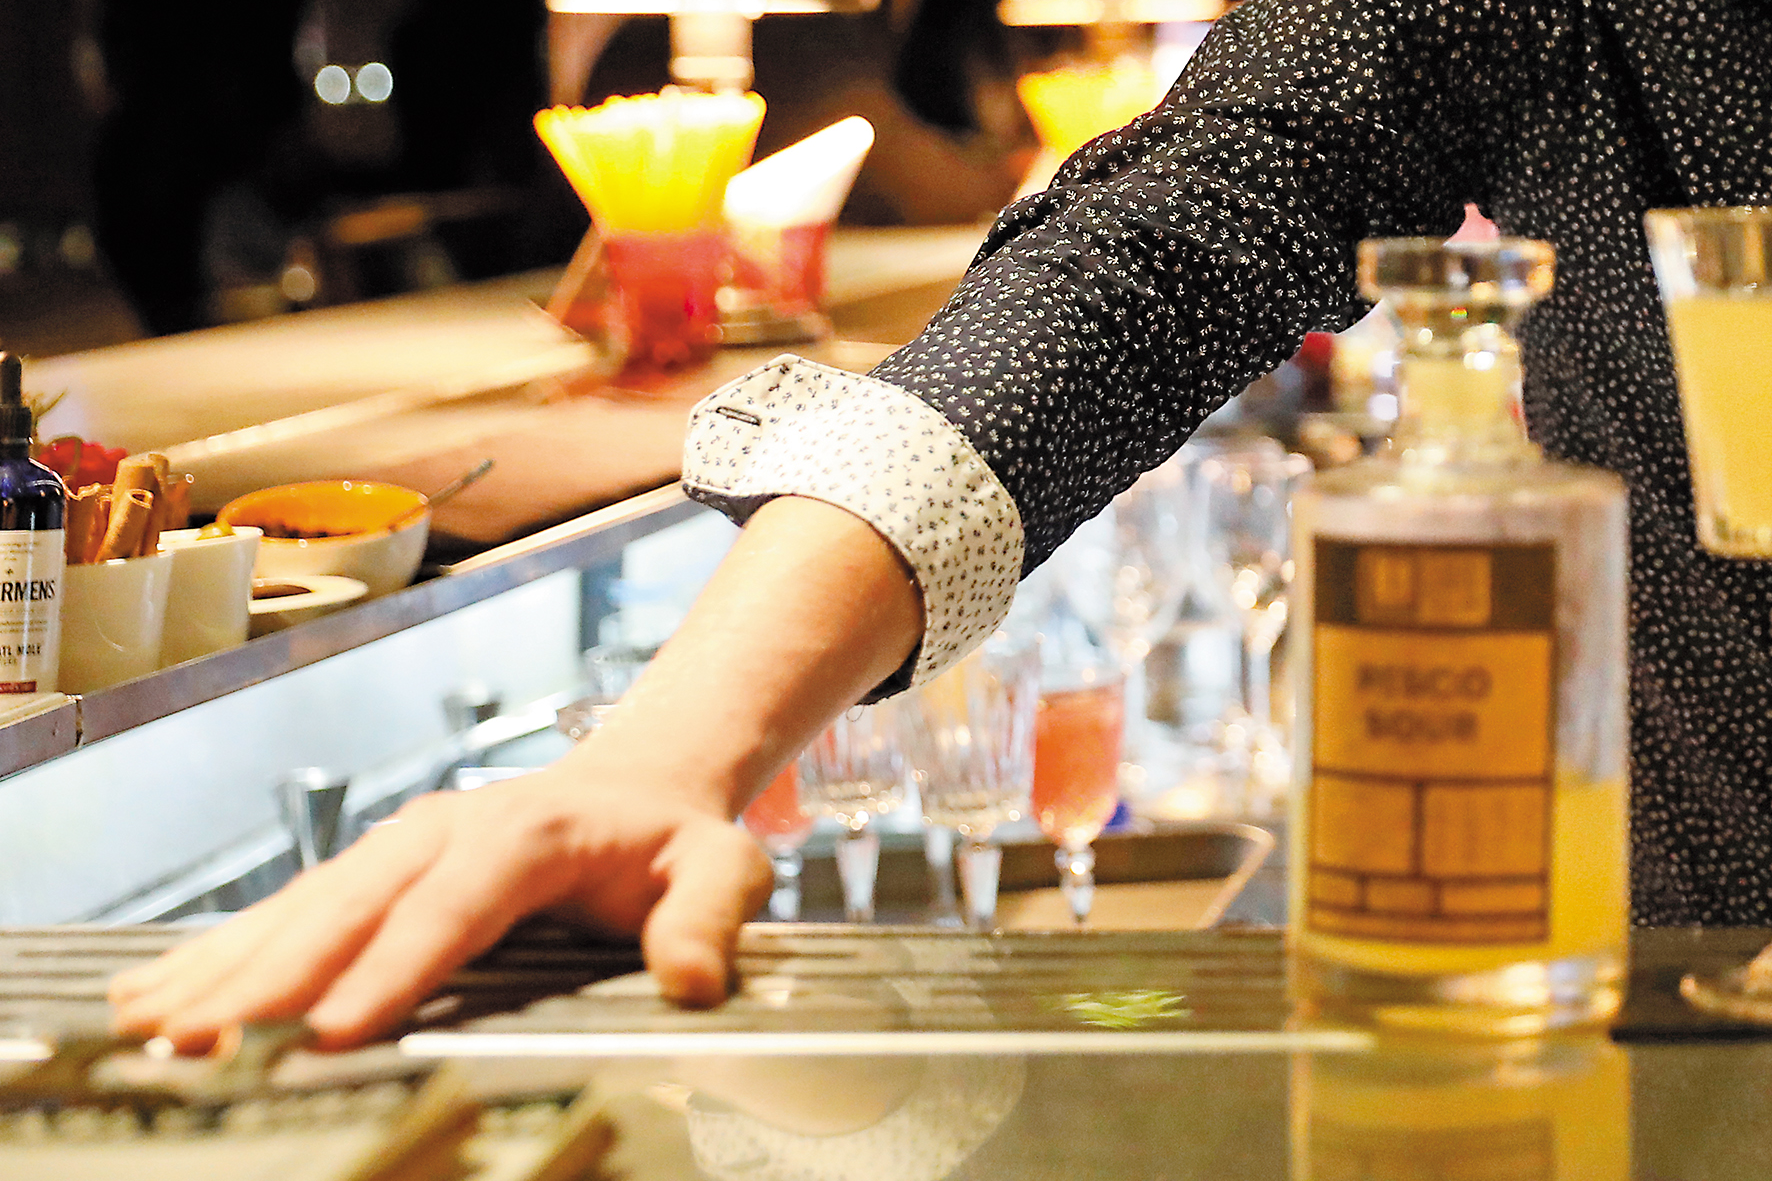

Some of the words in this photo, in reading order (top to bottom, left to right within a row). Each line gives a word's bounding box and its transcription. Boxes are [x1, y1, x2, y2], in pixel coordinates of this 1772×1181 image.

[0, 579, 56, 601] RMENS
[1355, 662, 1493, 701] PISCO
[1364, 706, 1480, 744] SOUR
